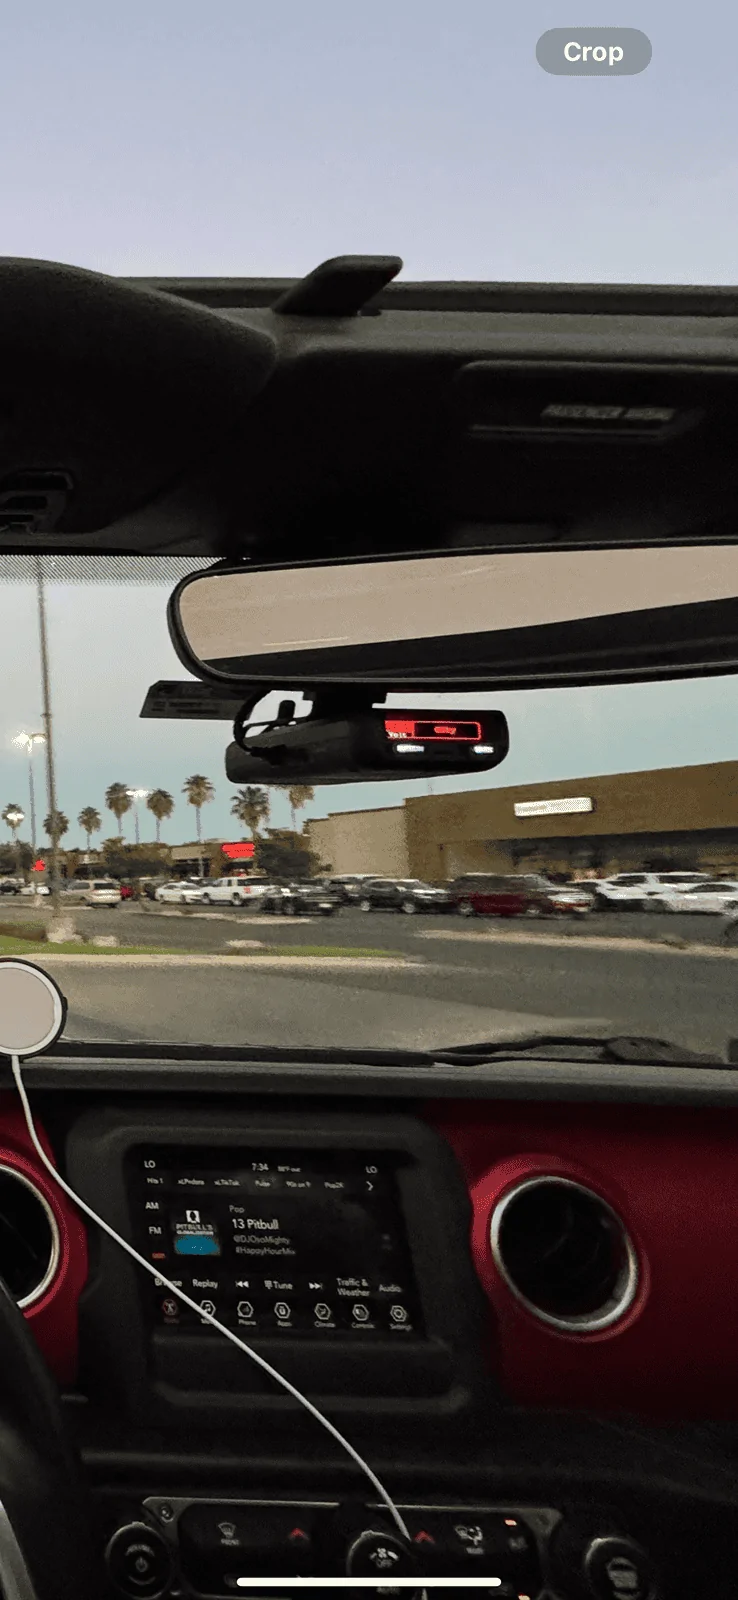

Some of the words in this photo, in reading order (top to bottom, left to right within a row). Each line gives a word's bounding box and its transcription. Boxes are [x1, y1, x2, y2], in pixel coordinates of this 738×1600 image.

[144, 1160, 156, 1168] LO
[252, 1163, 269, 1171] 7:34
[366, 1166, 378, 1174] LO
[145, 1202, 159, 1210] AM
[229, 1205, 245, 1213] Pop
[232, 1219, 245, 1229] 13
[247, 1218, 279, 1230] Pitbull
[149, 1227, 162, 1235] FM
[154, 1277, 183, 1287] Brse
[192, 1279, 219, 1289] Replay
[273, 1281, 293, 1290] Tune
[336, 1278, 360, 1287] Traffic
[361, 1279, 369, 1287] &
[379, 1284, 402, 1292] Audio
[338, 1288, 370, 1297] Weather
